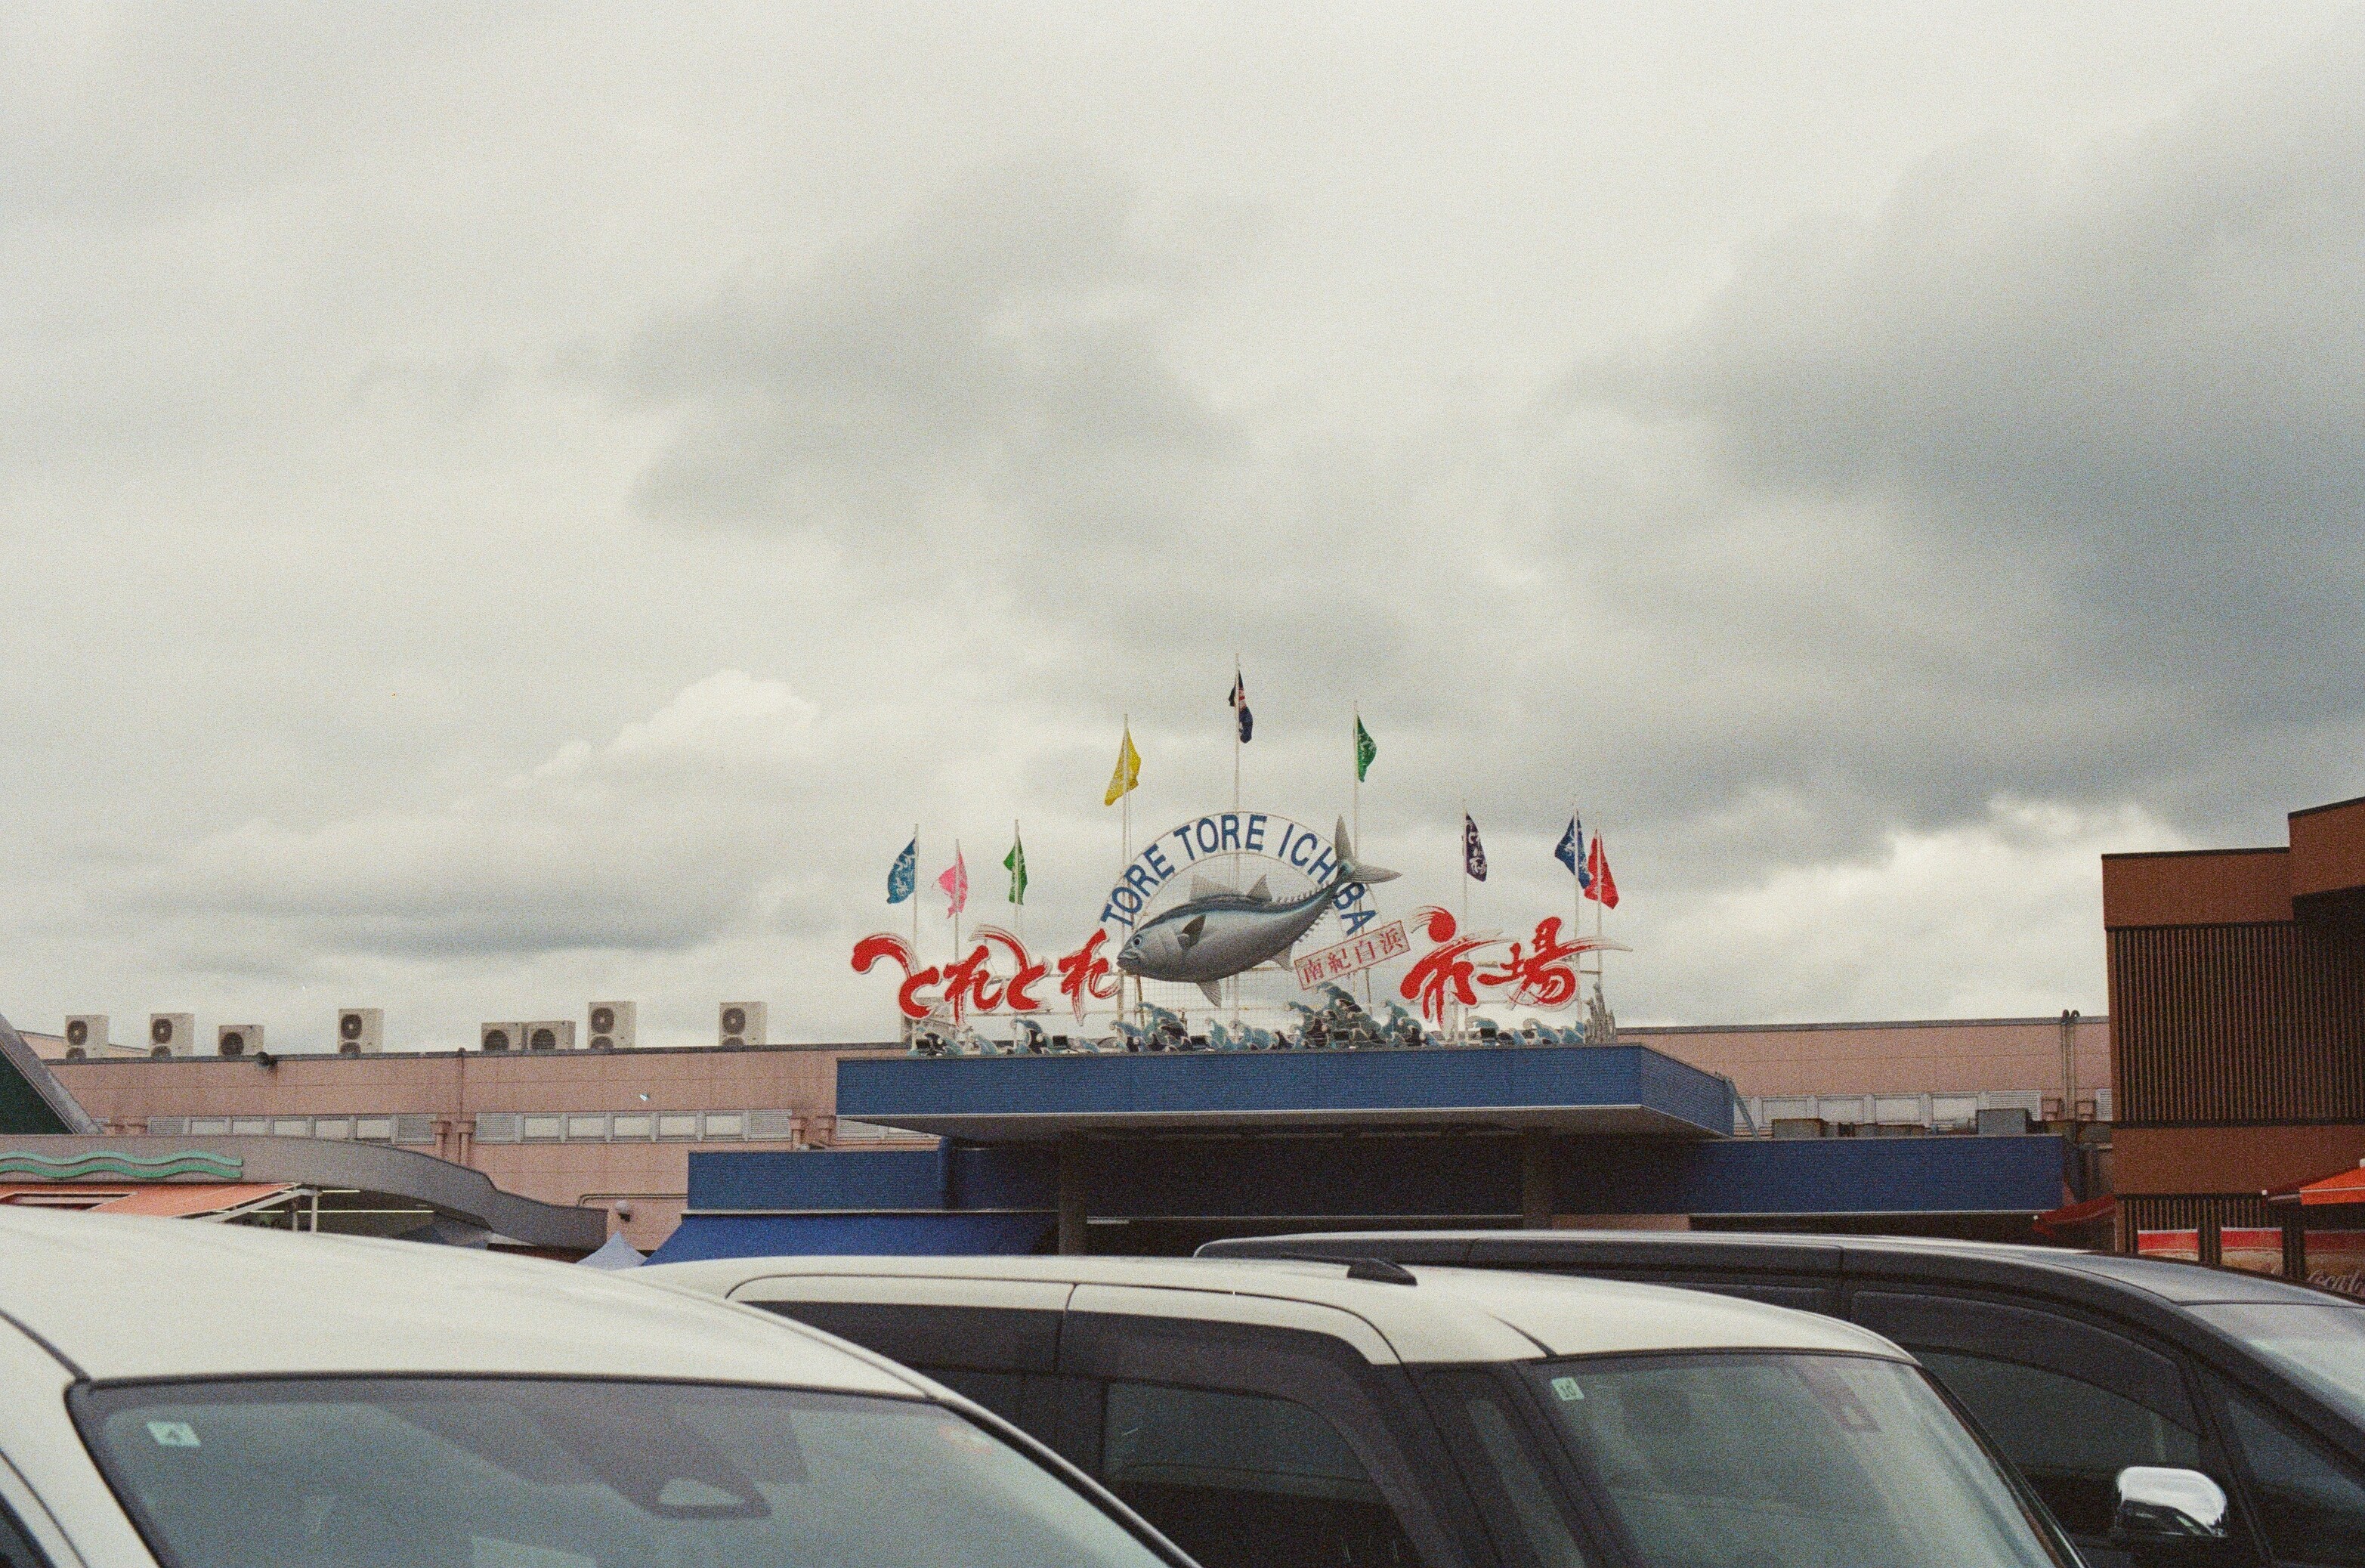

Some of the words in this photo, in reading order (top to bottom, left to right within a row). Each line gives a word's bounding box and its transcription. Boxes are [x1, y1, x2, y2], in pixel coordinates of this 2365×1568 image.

[1101, 843, 1176, 926] TORE
[1173, 814, 1268, 861] TORE
[1278, 823, 1379, 936] ICHBA
[851, 923, 1121, 1027] とれとれ
[1400, 905, 1633, 1032] 市場
[1297, 928, 1404, 985] 南紀白浜
